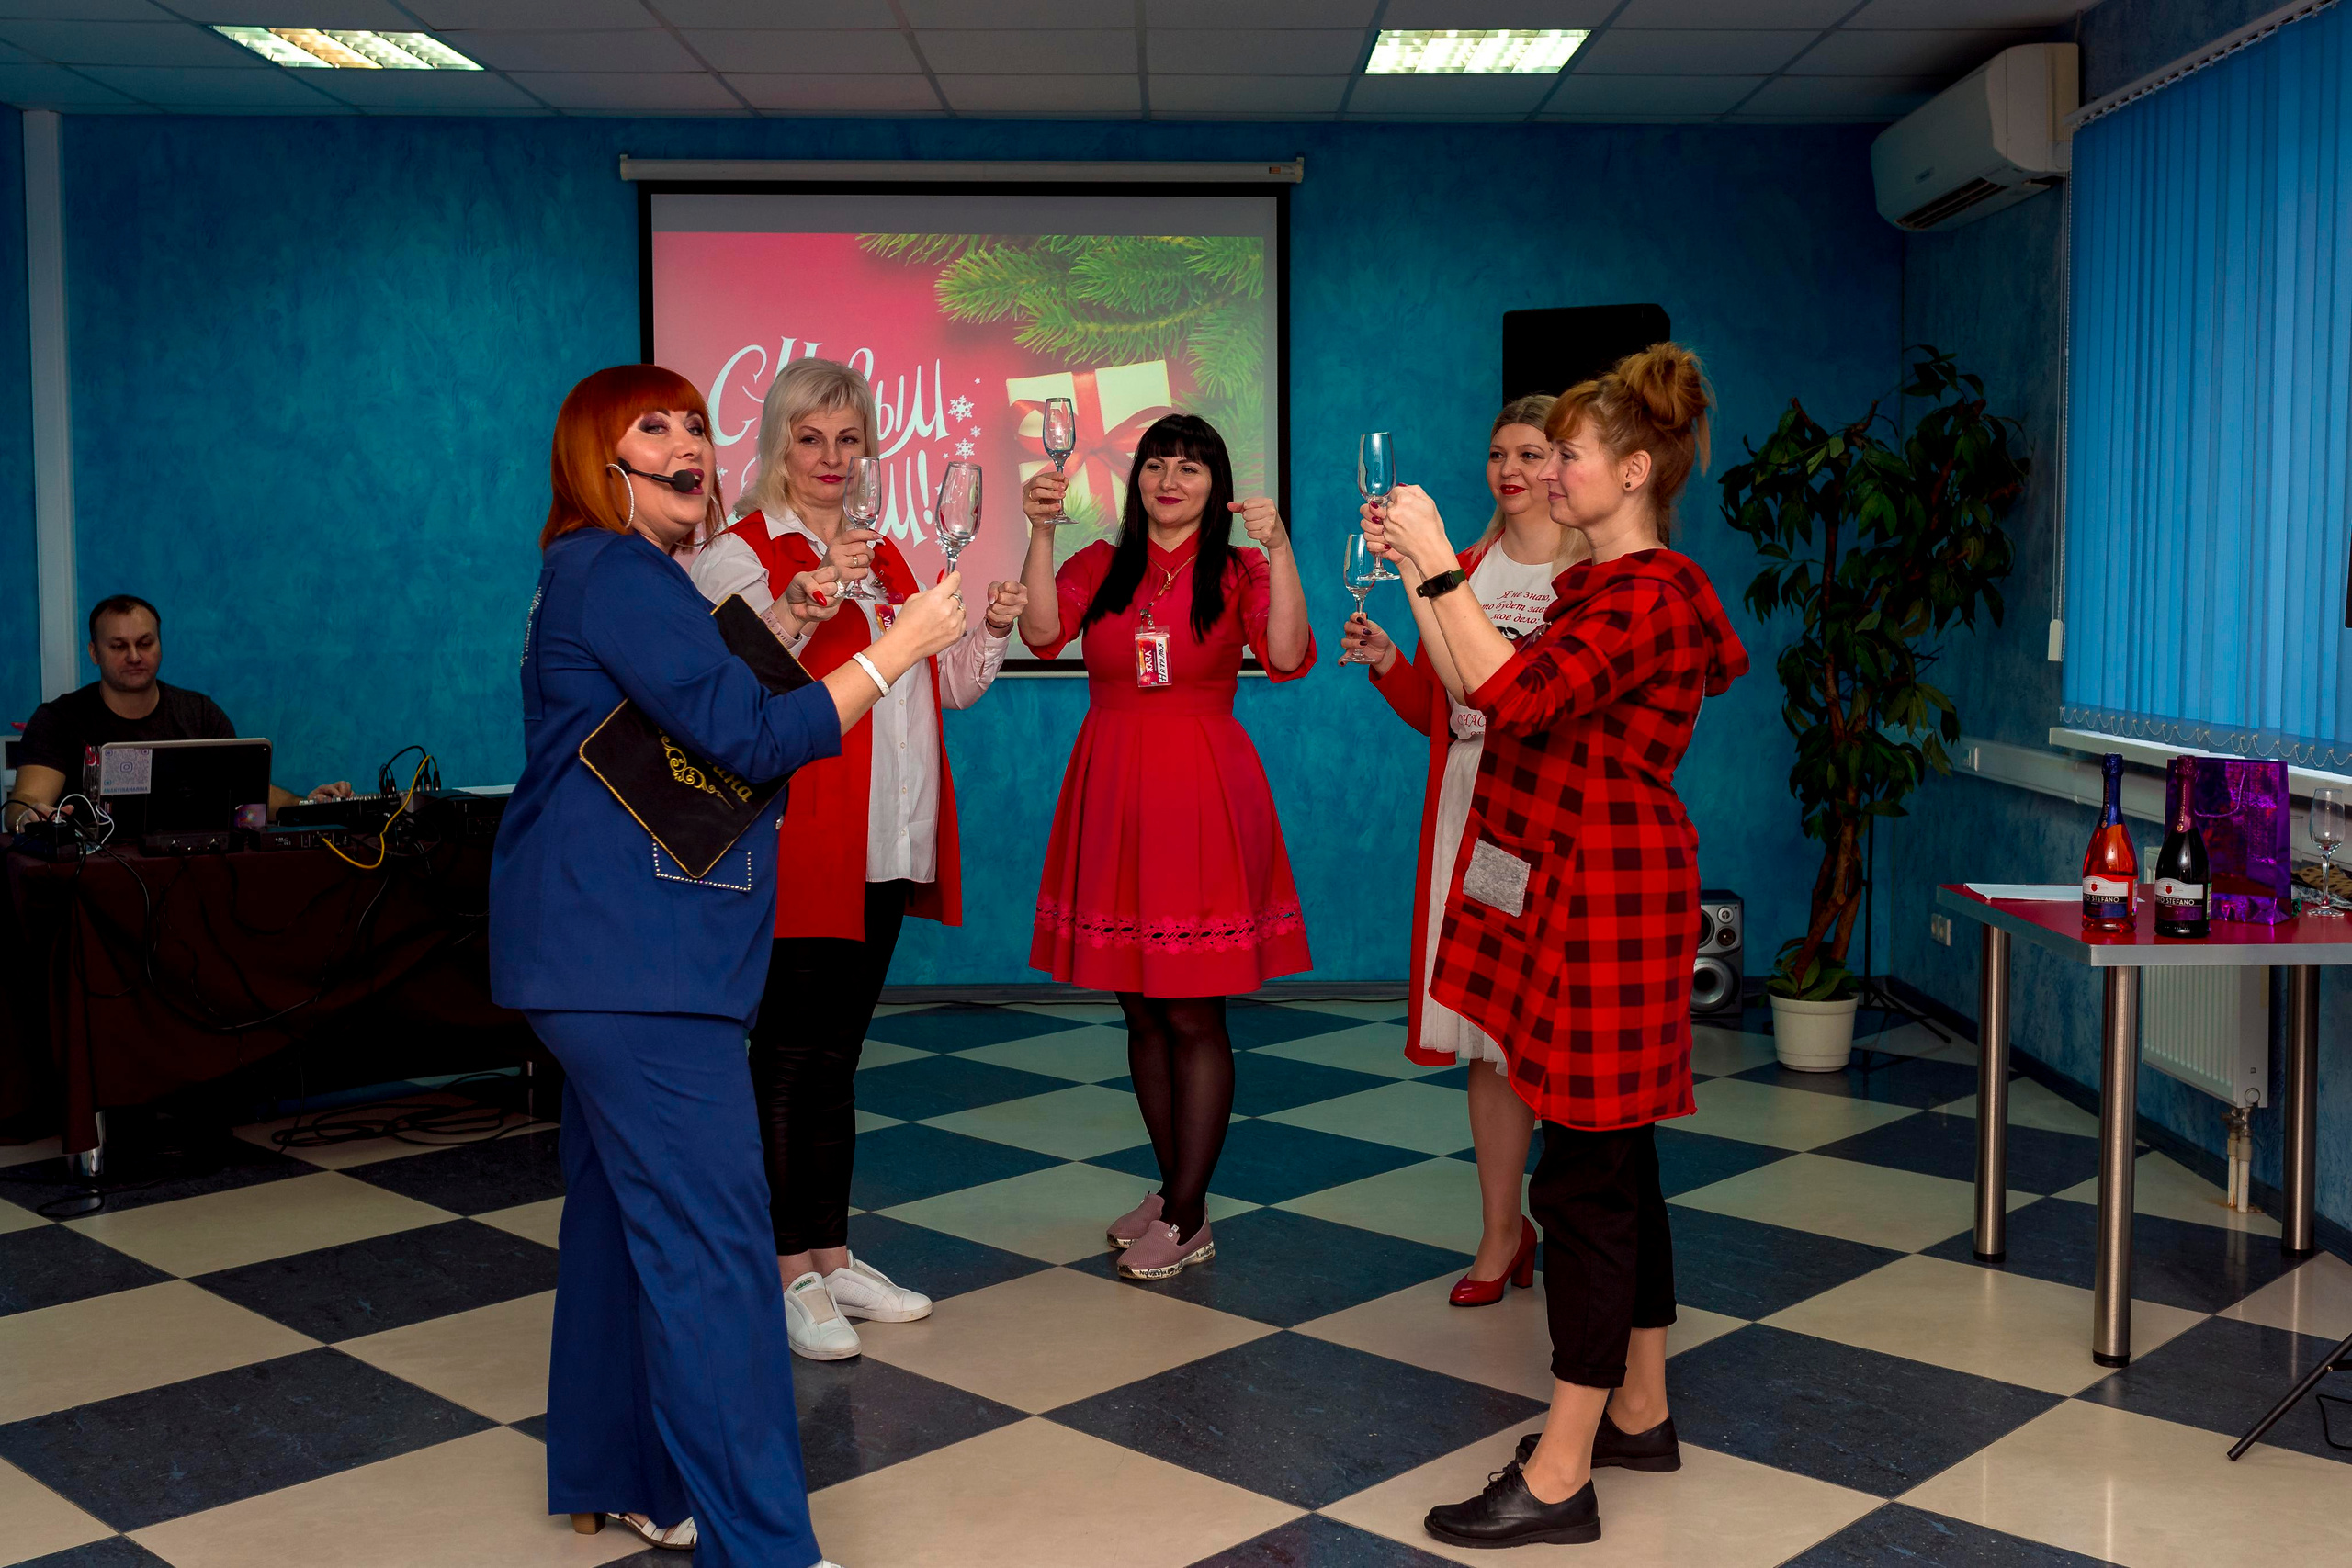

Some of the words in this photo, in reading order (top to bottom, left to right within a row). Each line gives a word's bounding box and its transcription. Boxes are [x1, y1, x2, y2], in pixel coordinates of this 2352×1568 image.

[707, 344, 768, 446] С
[1497, 590, 1513, 600] Я
[1523, 592, 1551, 602] знаю,
[1480, 603, 1495, 611] то
[1495, 600, 1526, 612] будет
[1527, 605, 1549, 614] зав
[1490, 613, 1512, 621] мое
[1513, 613, 1541, 625] дело:
[711, 763, 753, 804] ина
[2091, 895, 2120, 904] STEFANO
[2165, 897, 2195, 907] STEFANO
[795, 1280, 812, 1291] adidas
